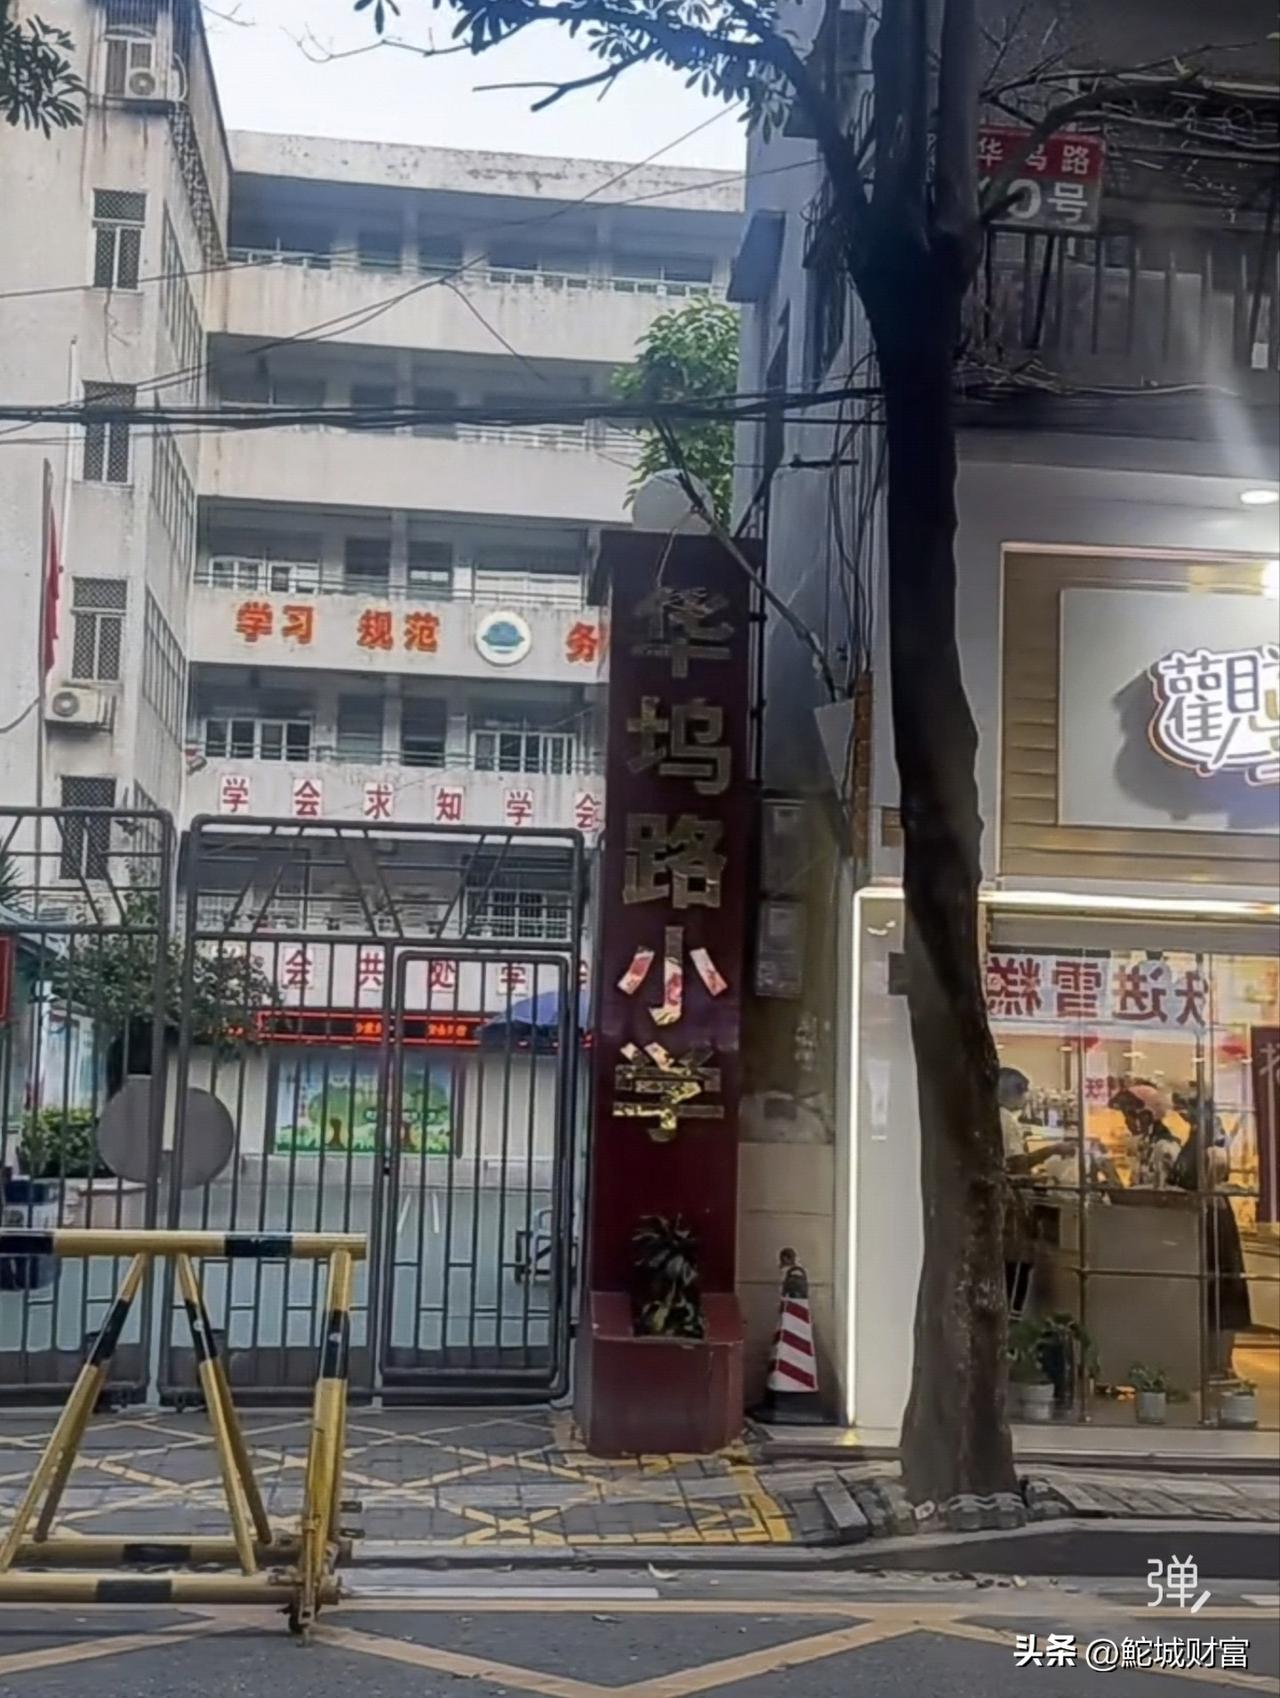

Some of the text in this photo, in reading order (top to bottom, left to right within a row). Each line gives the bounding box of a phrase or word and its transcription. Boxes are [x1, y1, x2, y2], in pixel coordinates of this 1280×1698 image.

[979, 176, 1087, 223] 0号
[236, 602, 606, 664] 学习 规范 务
[1162, 652, 1280, 776] 觀
[612, 586, 735, 1141] 华坞路小学
